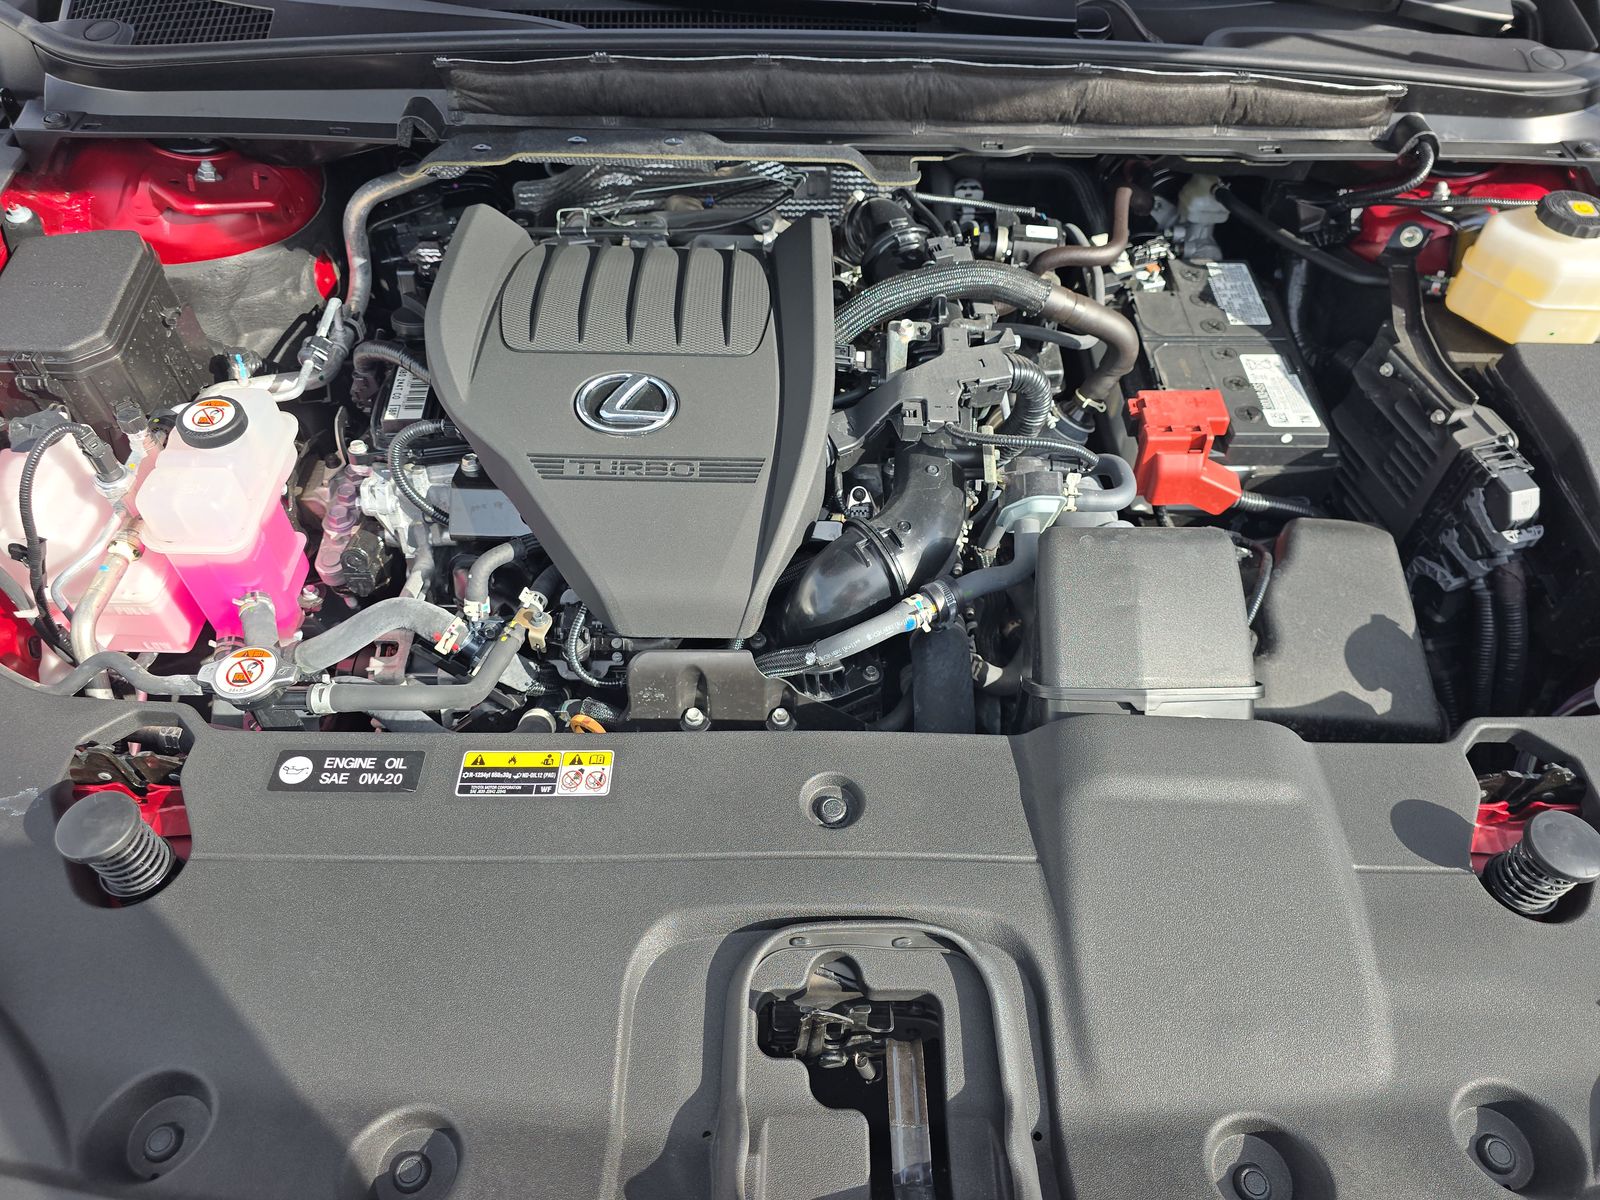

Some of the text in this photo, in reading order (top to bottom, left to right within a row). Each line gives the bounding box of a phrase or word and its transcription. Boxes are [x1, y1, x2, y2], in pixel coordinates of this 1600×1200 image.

[568, 458, 695, 478] TURBO
[323, 757, 408, 770] ENGINE OIL
[318, 772, 404, 786] SAE 0W-20
[540, 785, 552, 793] WF
